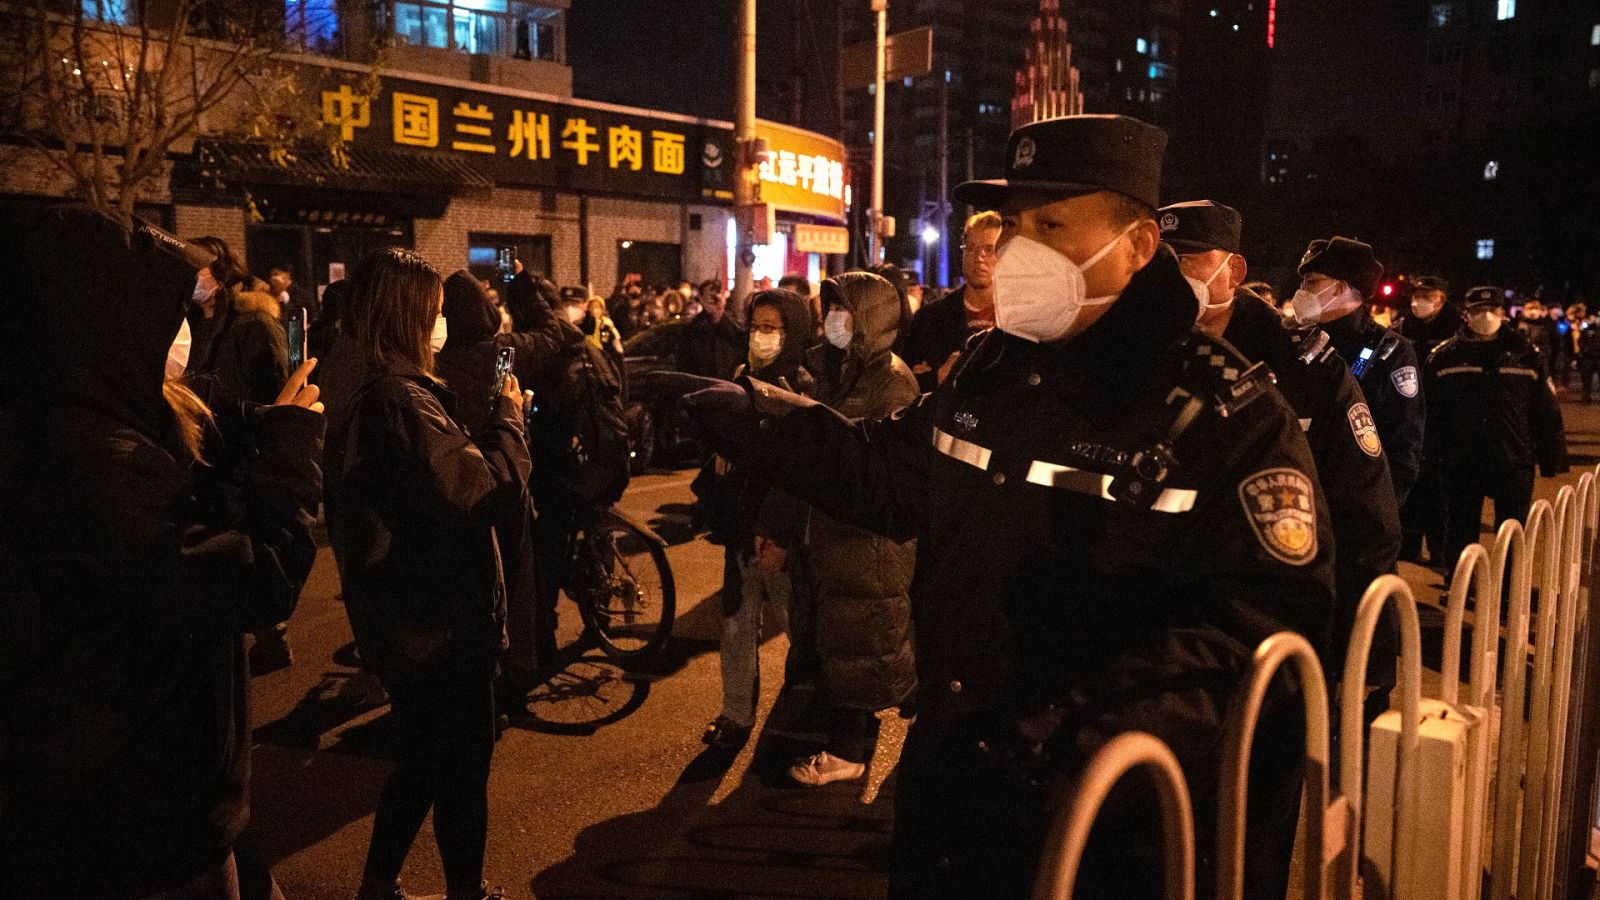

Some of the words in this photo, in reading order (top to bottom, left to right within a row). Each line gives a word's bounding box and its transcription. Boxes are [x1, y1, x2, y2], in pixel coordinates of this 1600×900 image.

[321, 84, 686, 175] 中国兰州牛肉面
